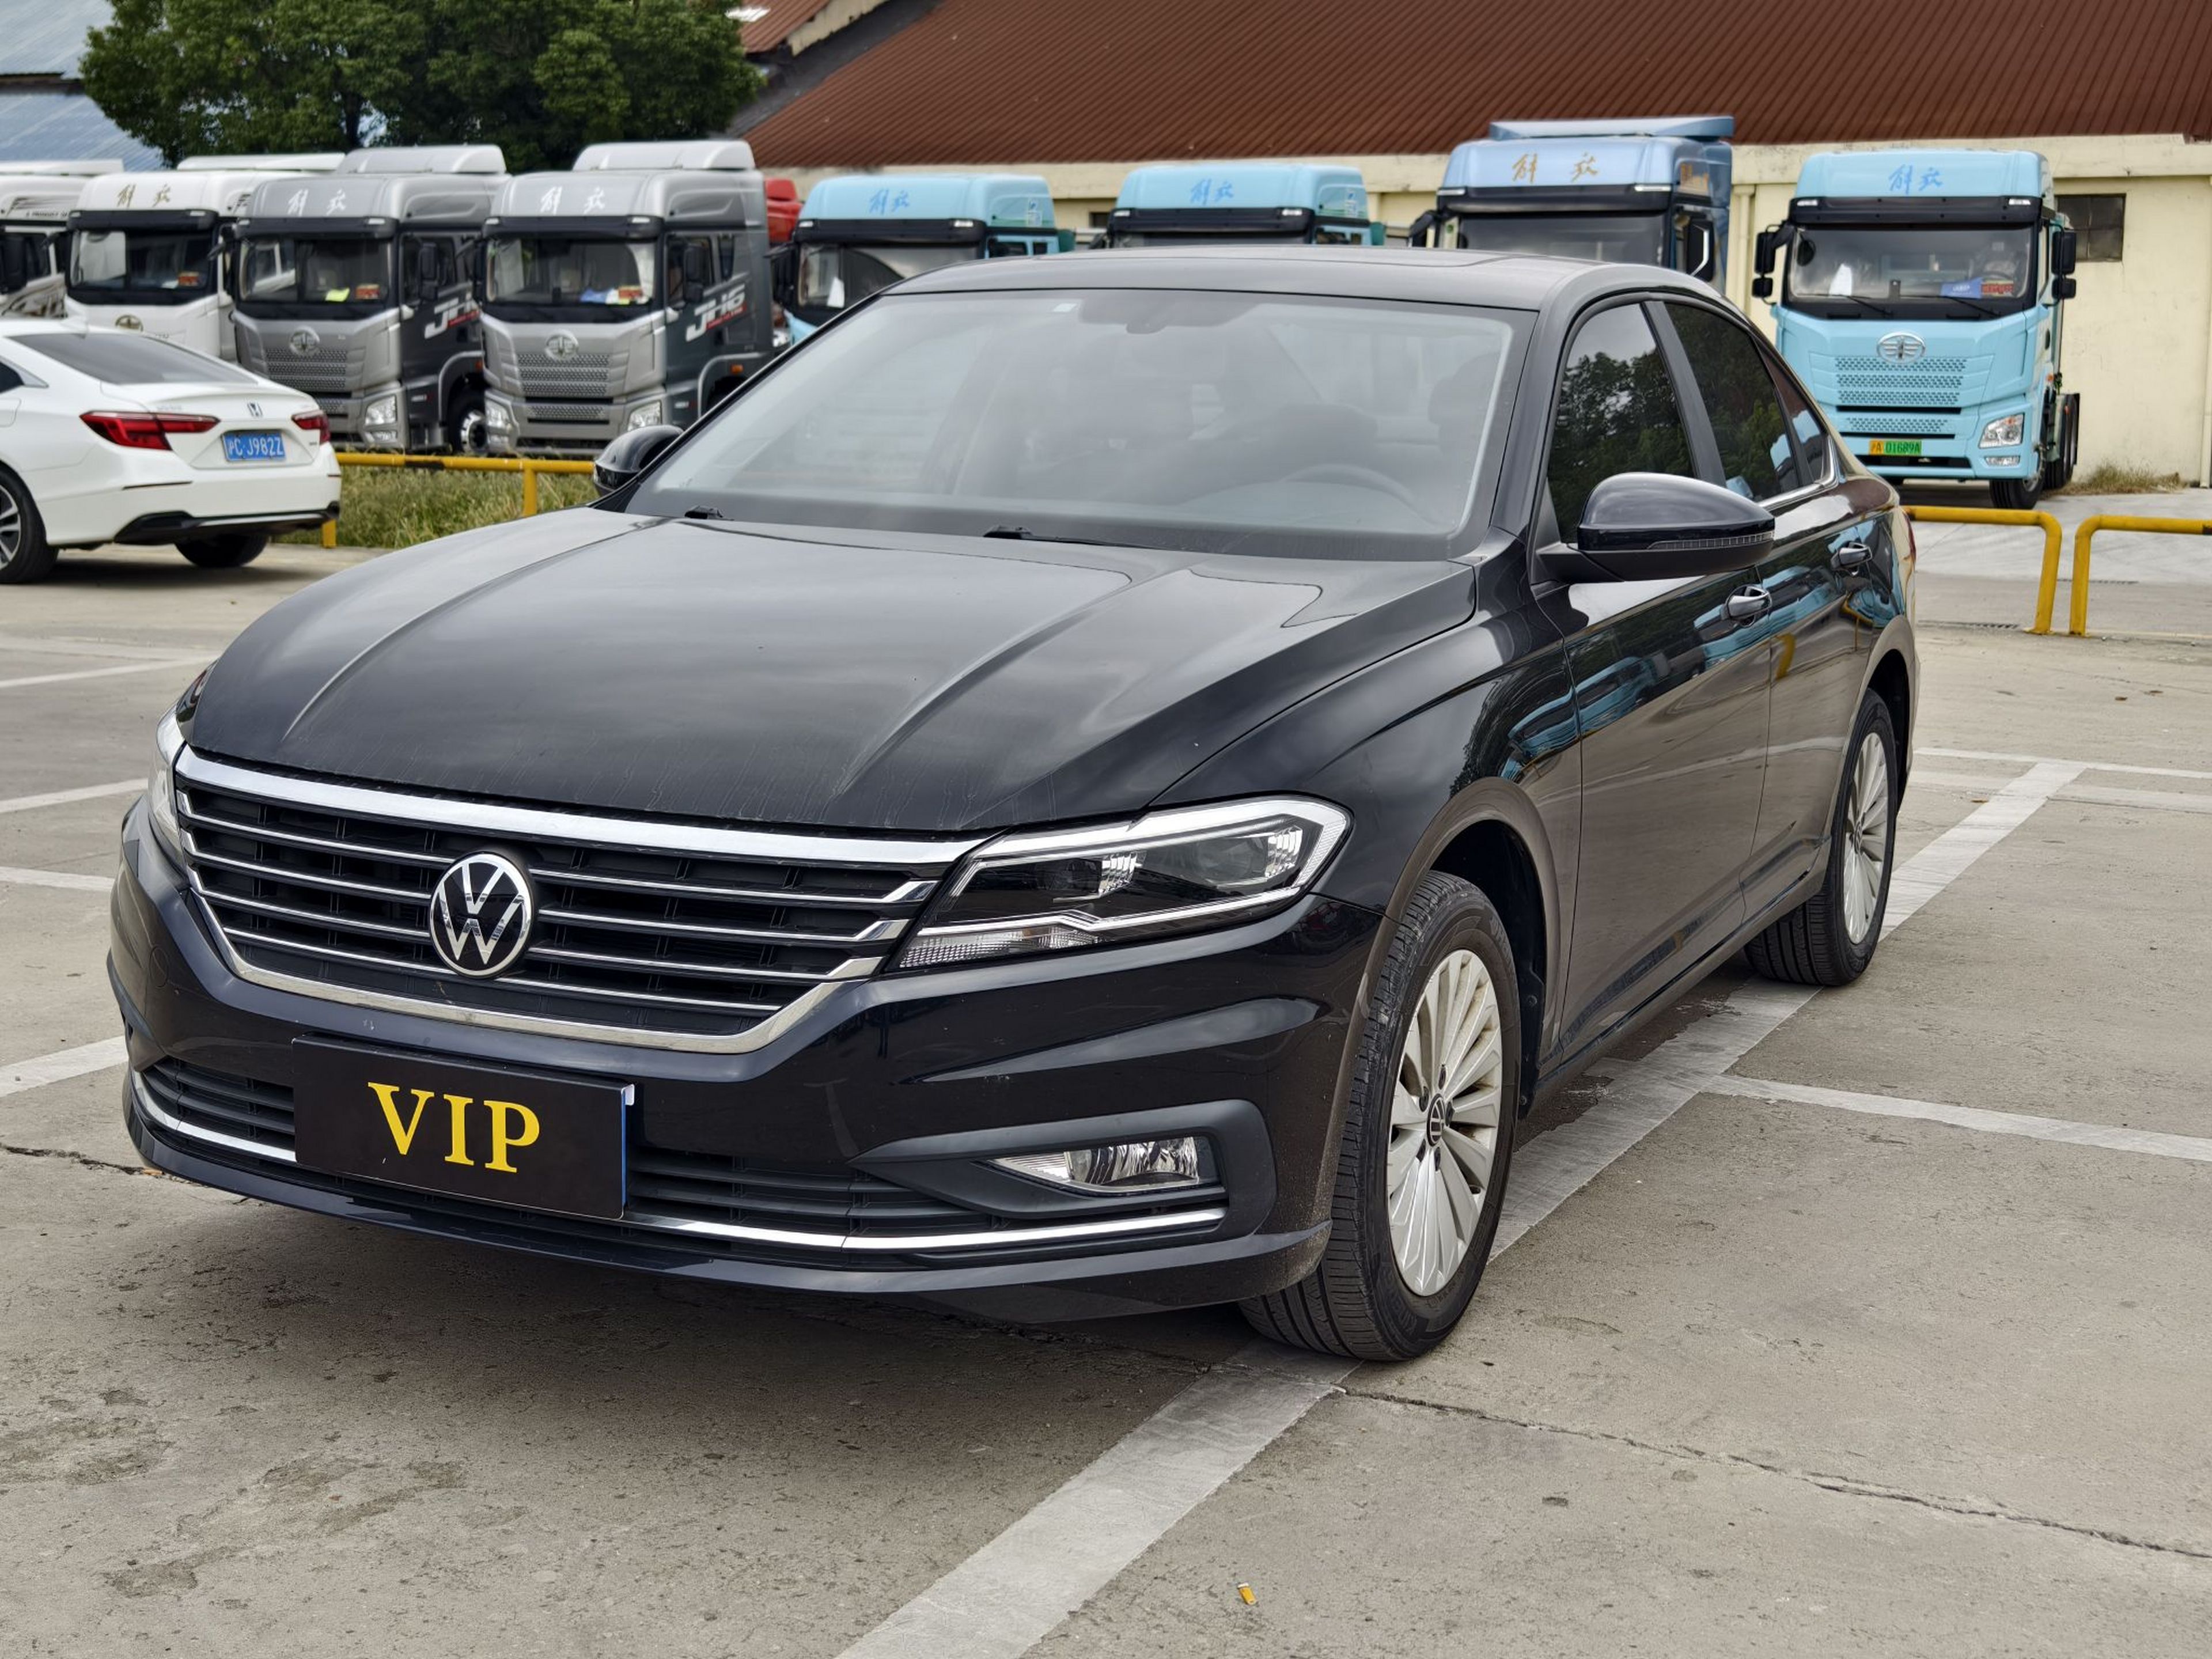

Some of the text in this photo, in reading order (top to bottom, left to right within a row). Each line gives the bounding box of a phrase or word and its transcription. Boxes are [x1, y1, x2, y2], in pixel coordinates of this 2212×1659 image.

[1512, 151, 1598, 184] 解放
[1888, 164, 1944, 195] 解放
[117, 183, 171, 209] 解放
[287, 188, 346, 216] 解放
[540, 186, 605, 215] 解放
[424, 292, 479, 339] JH
[685, 283, 745, 342] JH6
[368, 1081, 540, 1173] VIP
